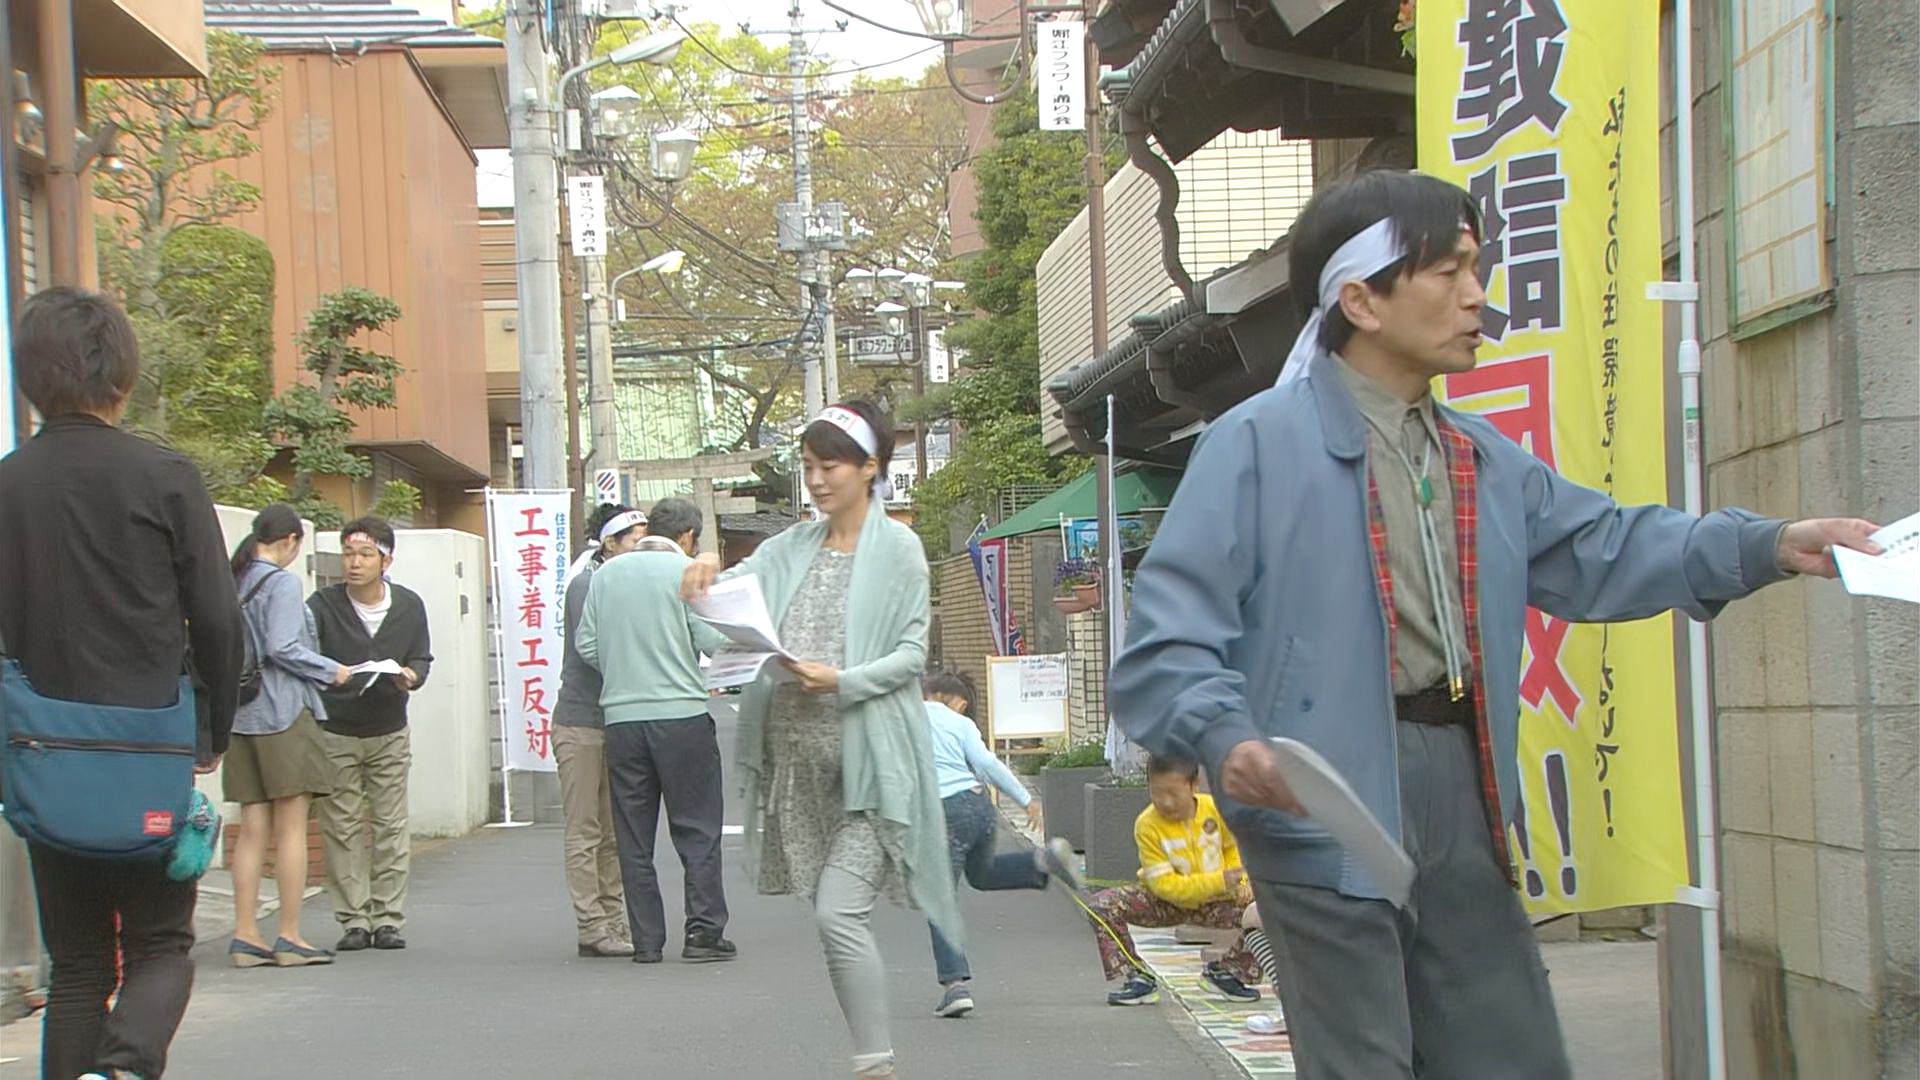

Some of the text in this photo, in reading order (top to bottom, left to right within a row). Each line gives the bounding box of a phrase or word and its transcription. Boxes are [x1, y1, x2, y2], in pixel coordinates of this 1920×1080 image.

[514, 506, 552, 761] 工事着工反対
[553, 512, 567, 638] 住民の合意なくして
